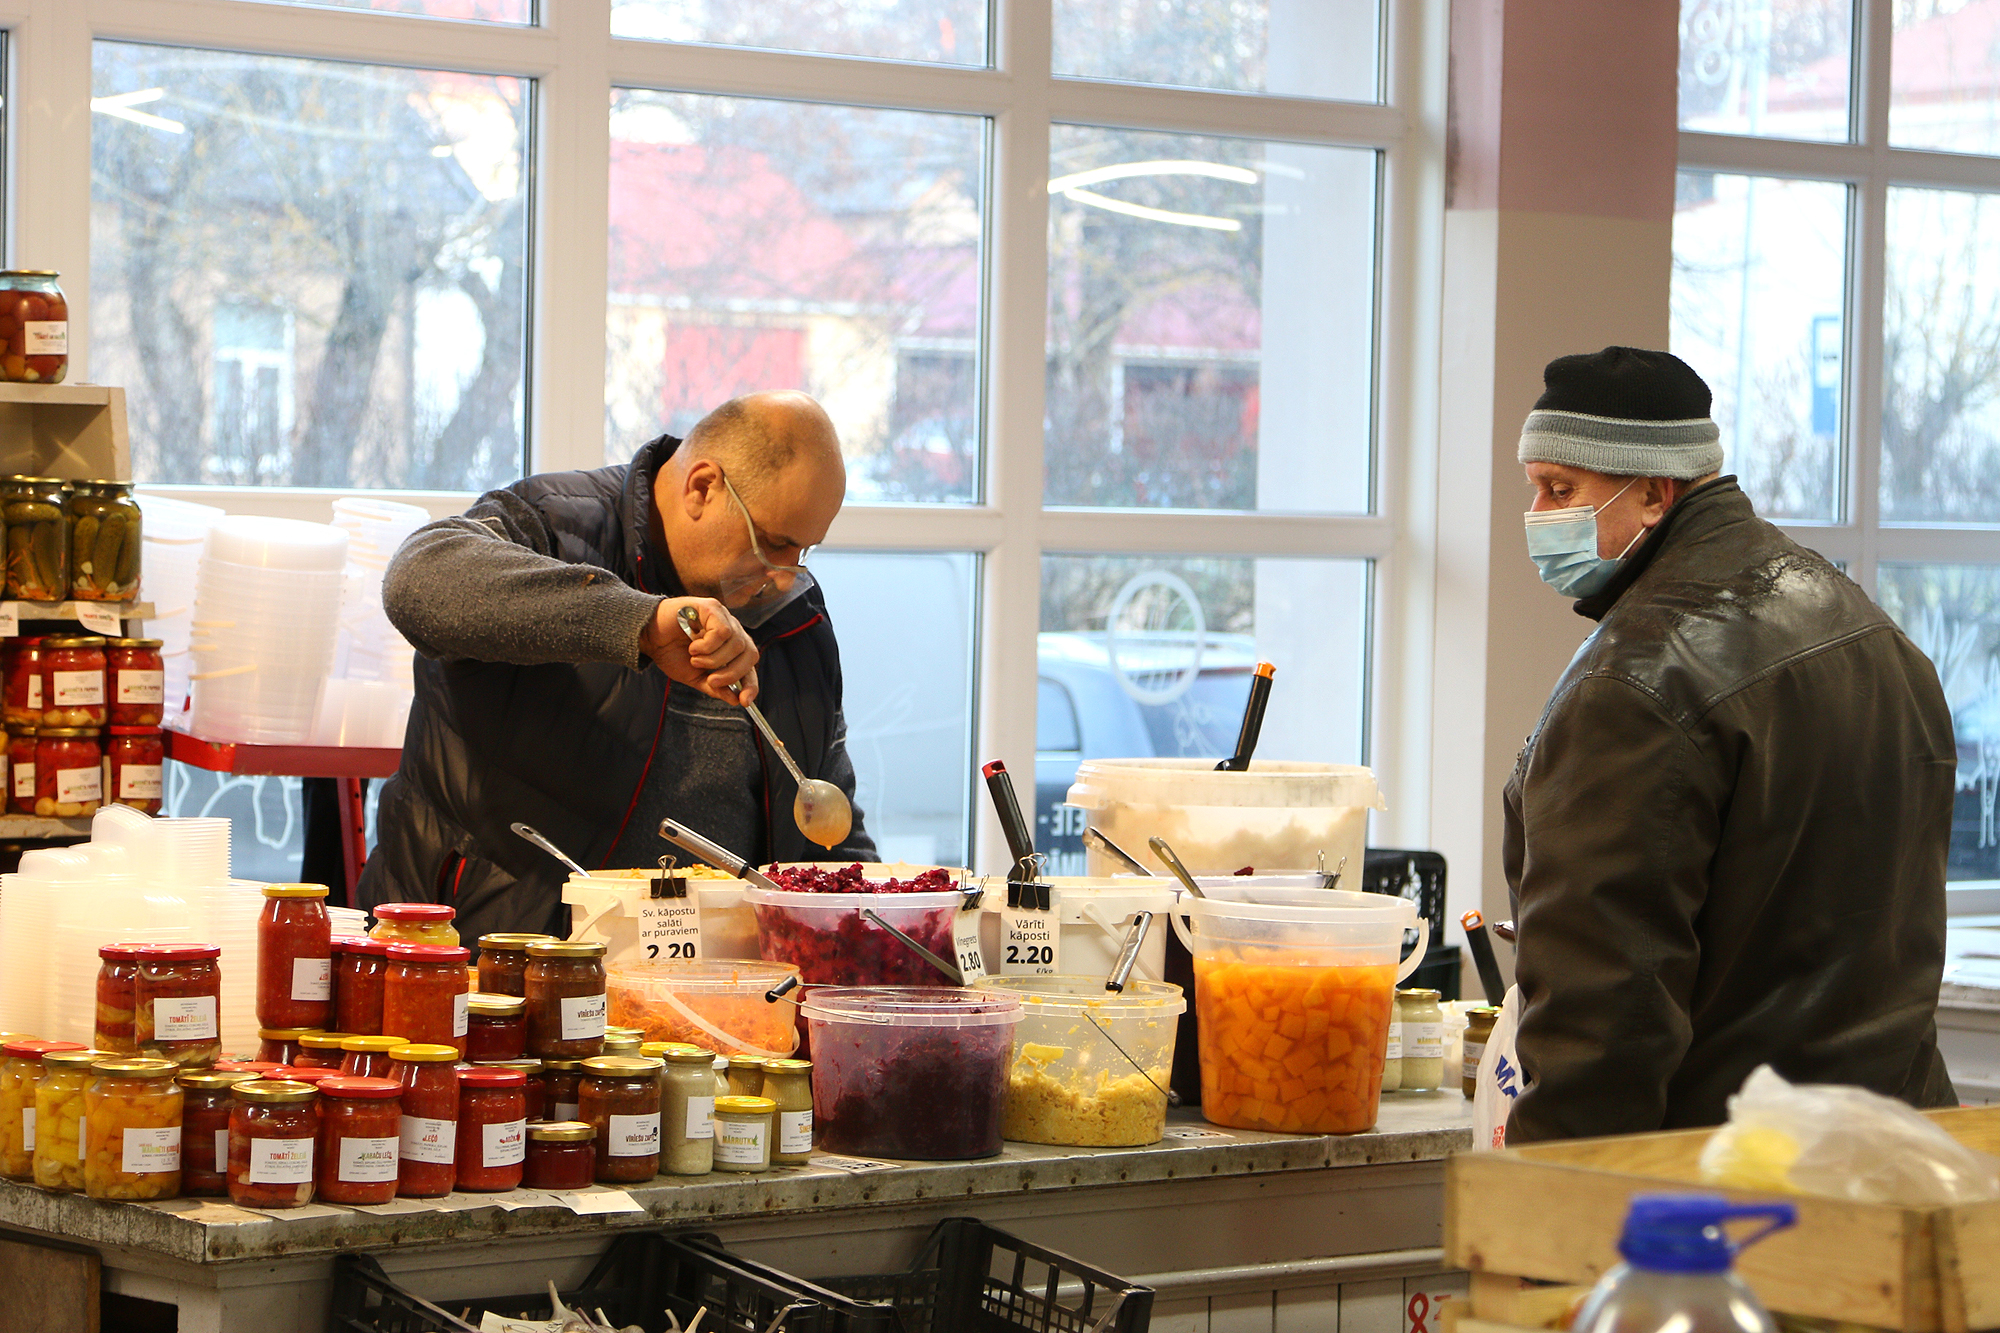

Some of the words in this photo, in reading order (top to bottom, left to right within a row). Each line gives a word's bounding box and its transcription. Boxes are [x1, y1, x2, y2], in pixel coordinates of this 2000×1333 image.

[642, 909, 655, 917] Sv.
[657, 908, 696, 918] kāpostu
[657, 919, 682, 928] salāti
[1016, 919, 1045, 929] Vārīti
[654, 927, 699, 939] puraviem
[1010, 930, 1050, 942] kāposti
[1006, 945, 1053, 964] 2.20
[960, 951, 981, 972] 2.80
